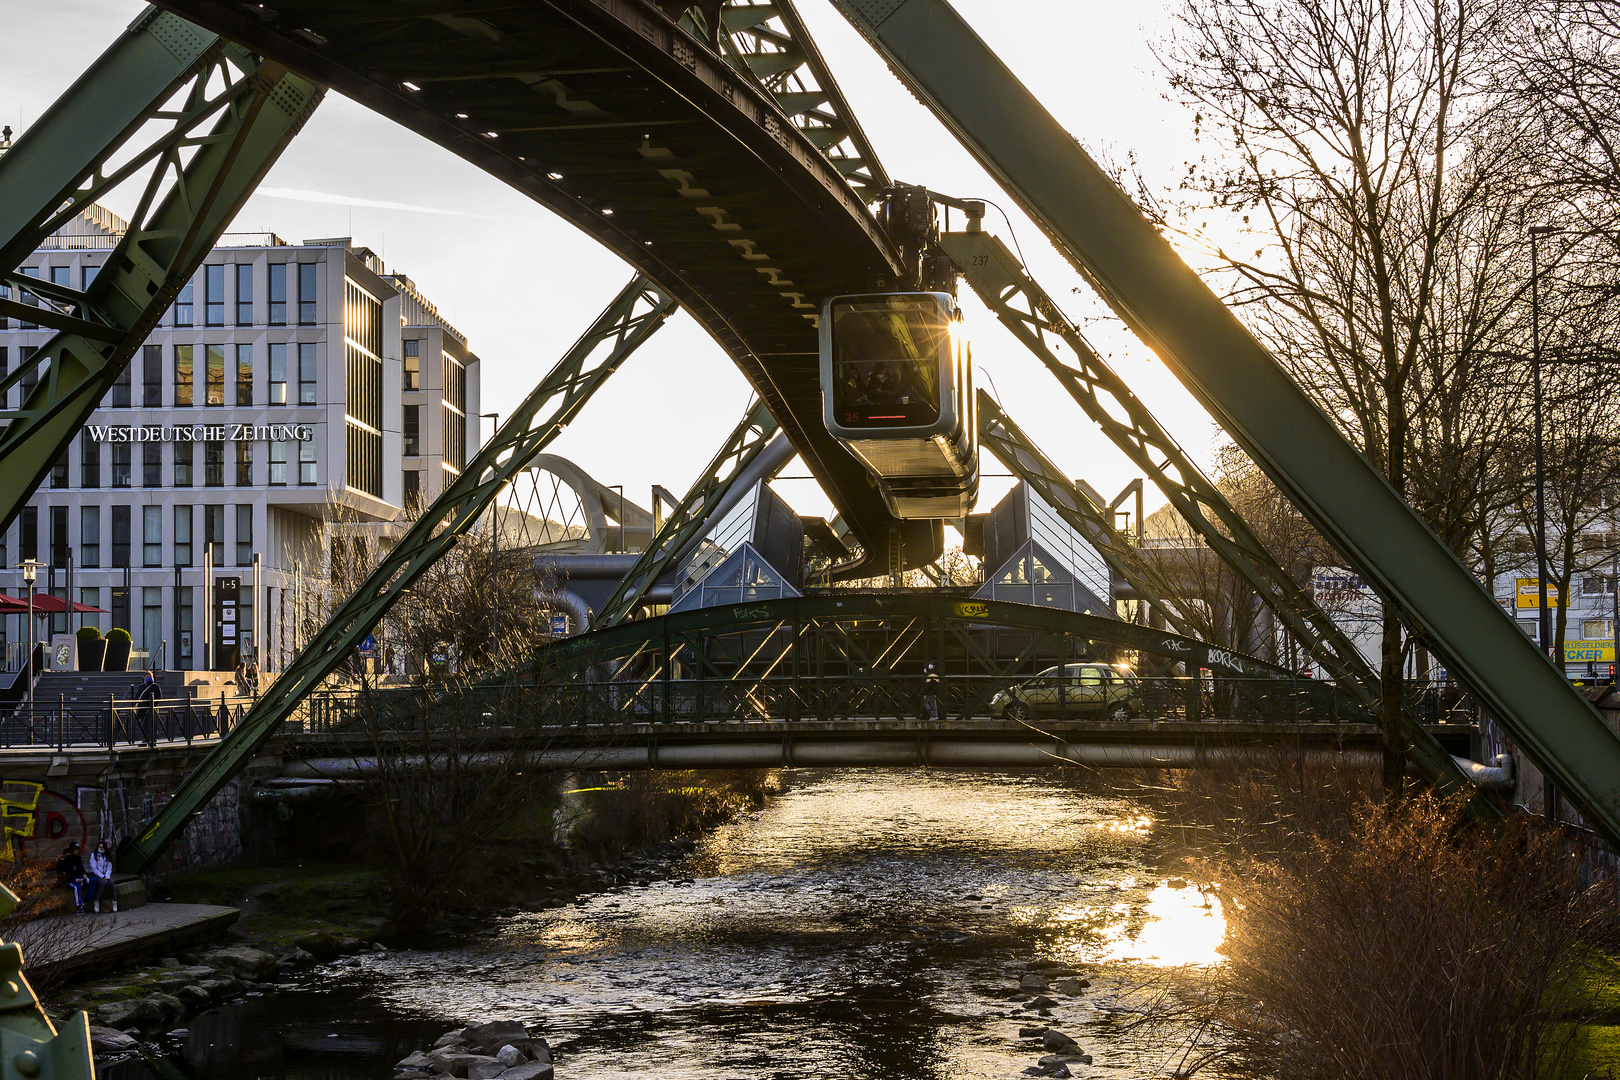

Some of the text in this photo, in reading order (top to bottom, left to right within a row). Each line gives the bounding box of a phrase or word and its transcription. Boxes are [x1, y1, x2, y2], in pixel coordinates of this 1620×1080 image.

[971, 255, 989, 266] 237
[845, 412, 859, 422] 25
[88, 424, 307, 441] WESTDEUTSCHE ZEITUNG
